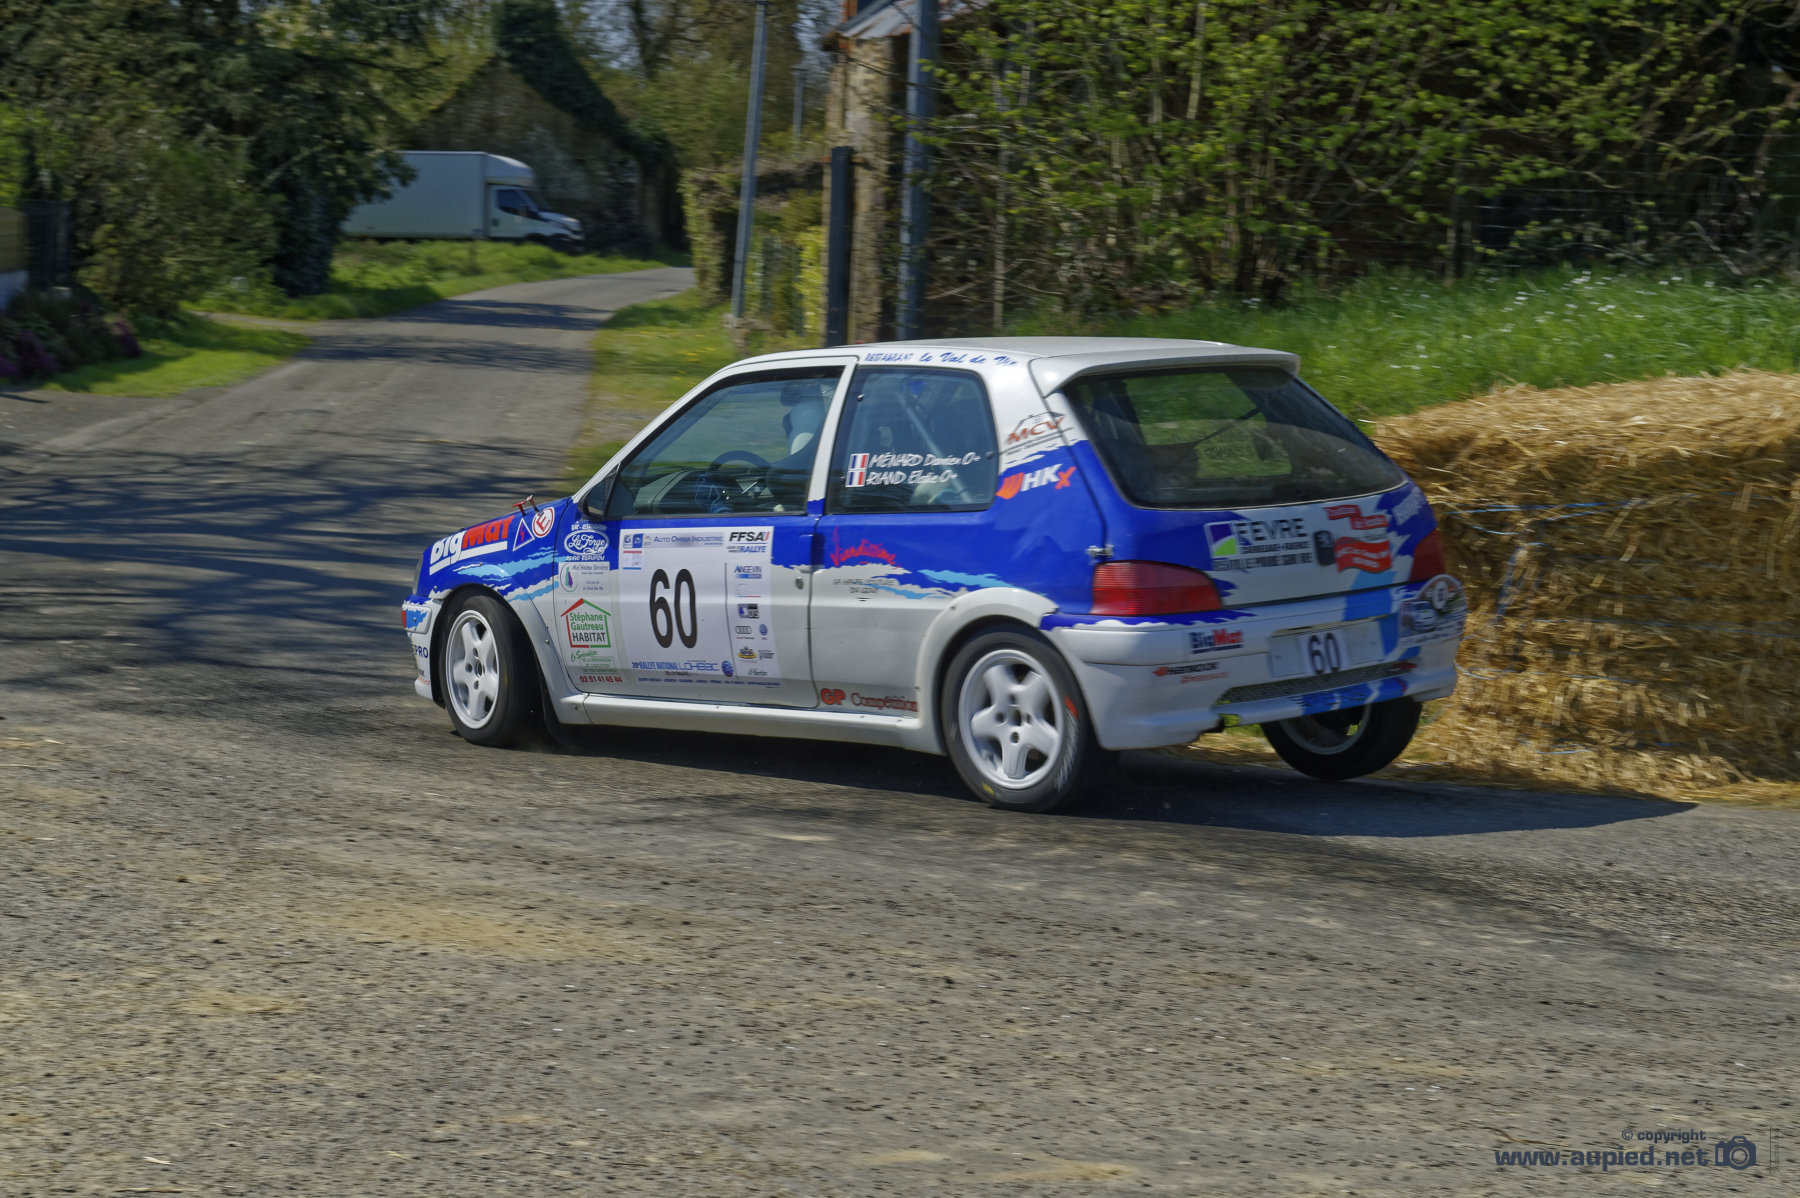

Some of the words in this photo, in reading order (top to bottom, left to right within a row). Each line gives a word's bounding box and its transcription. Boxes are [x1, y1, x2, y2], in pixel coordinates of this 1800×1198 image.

[729, 531, 764, 542] FFSA
[1235, 517, 1307, 542] FEVRE
[570, 611, 603, 623] Stéphane
[649, 568, 698, 649] 60
[572, 631, 606, 643] HABITAT
[1307, 632, 1342, 675] 60
[820, 687, 846, 706] GP
